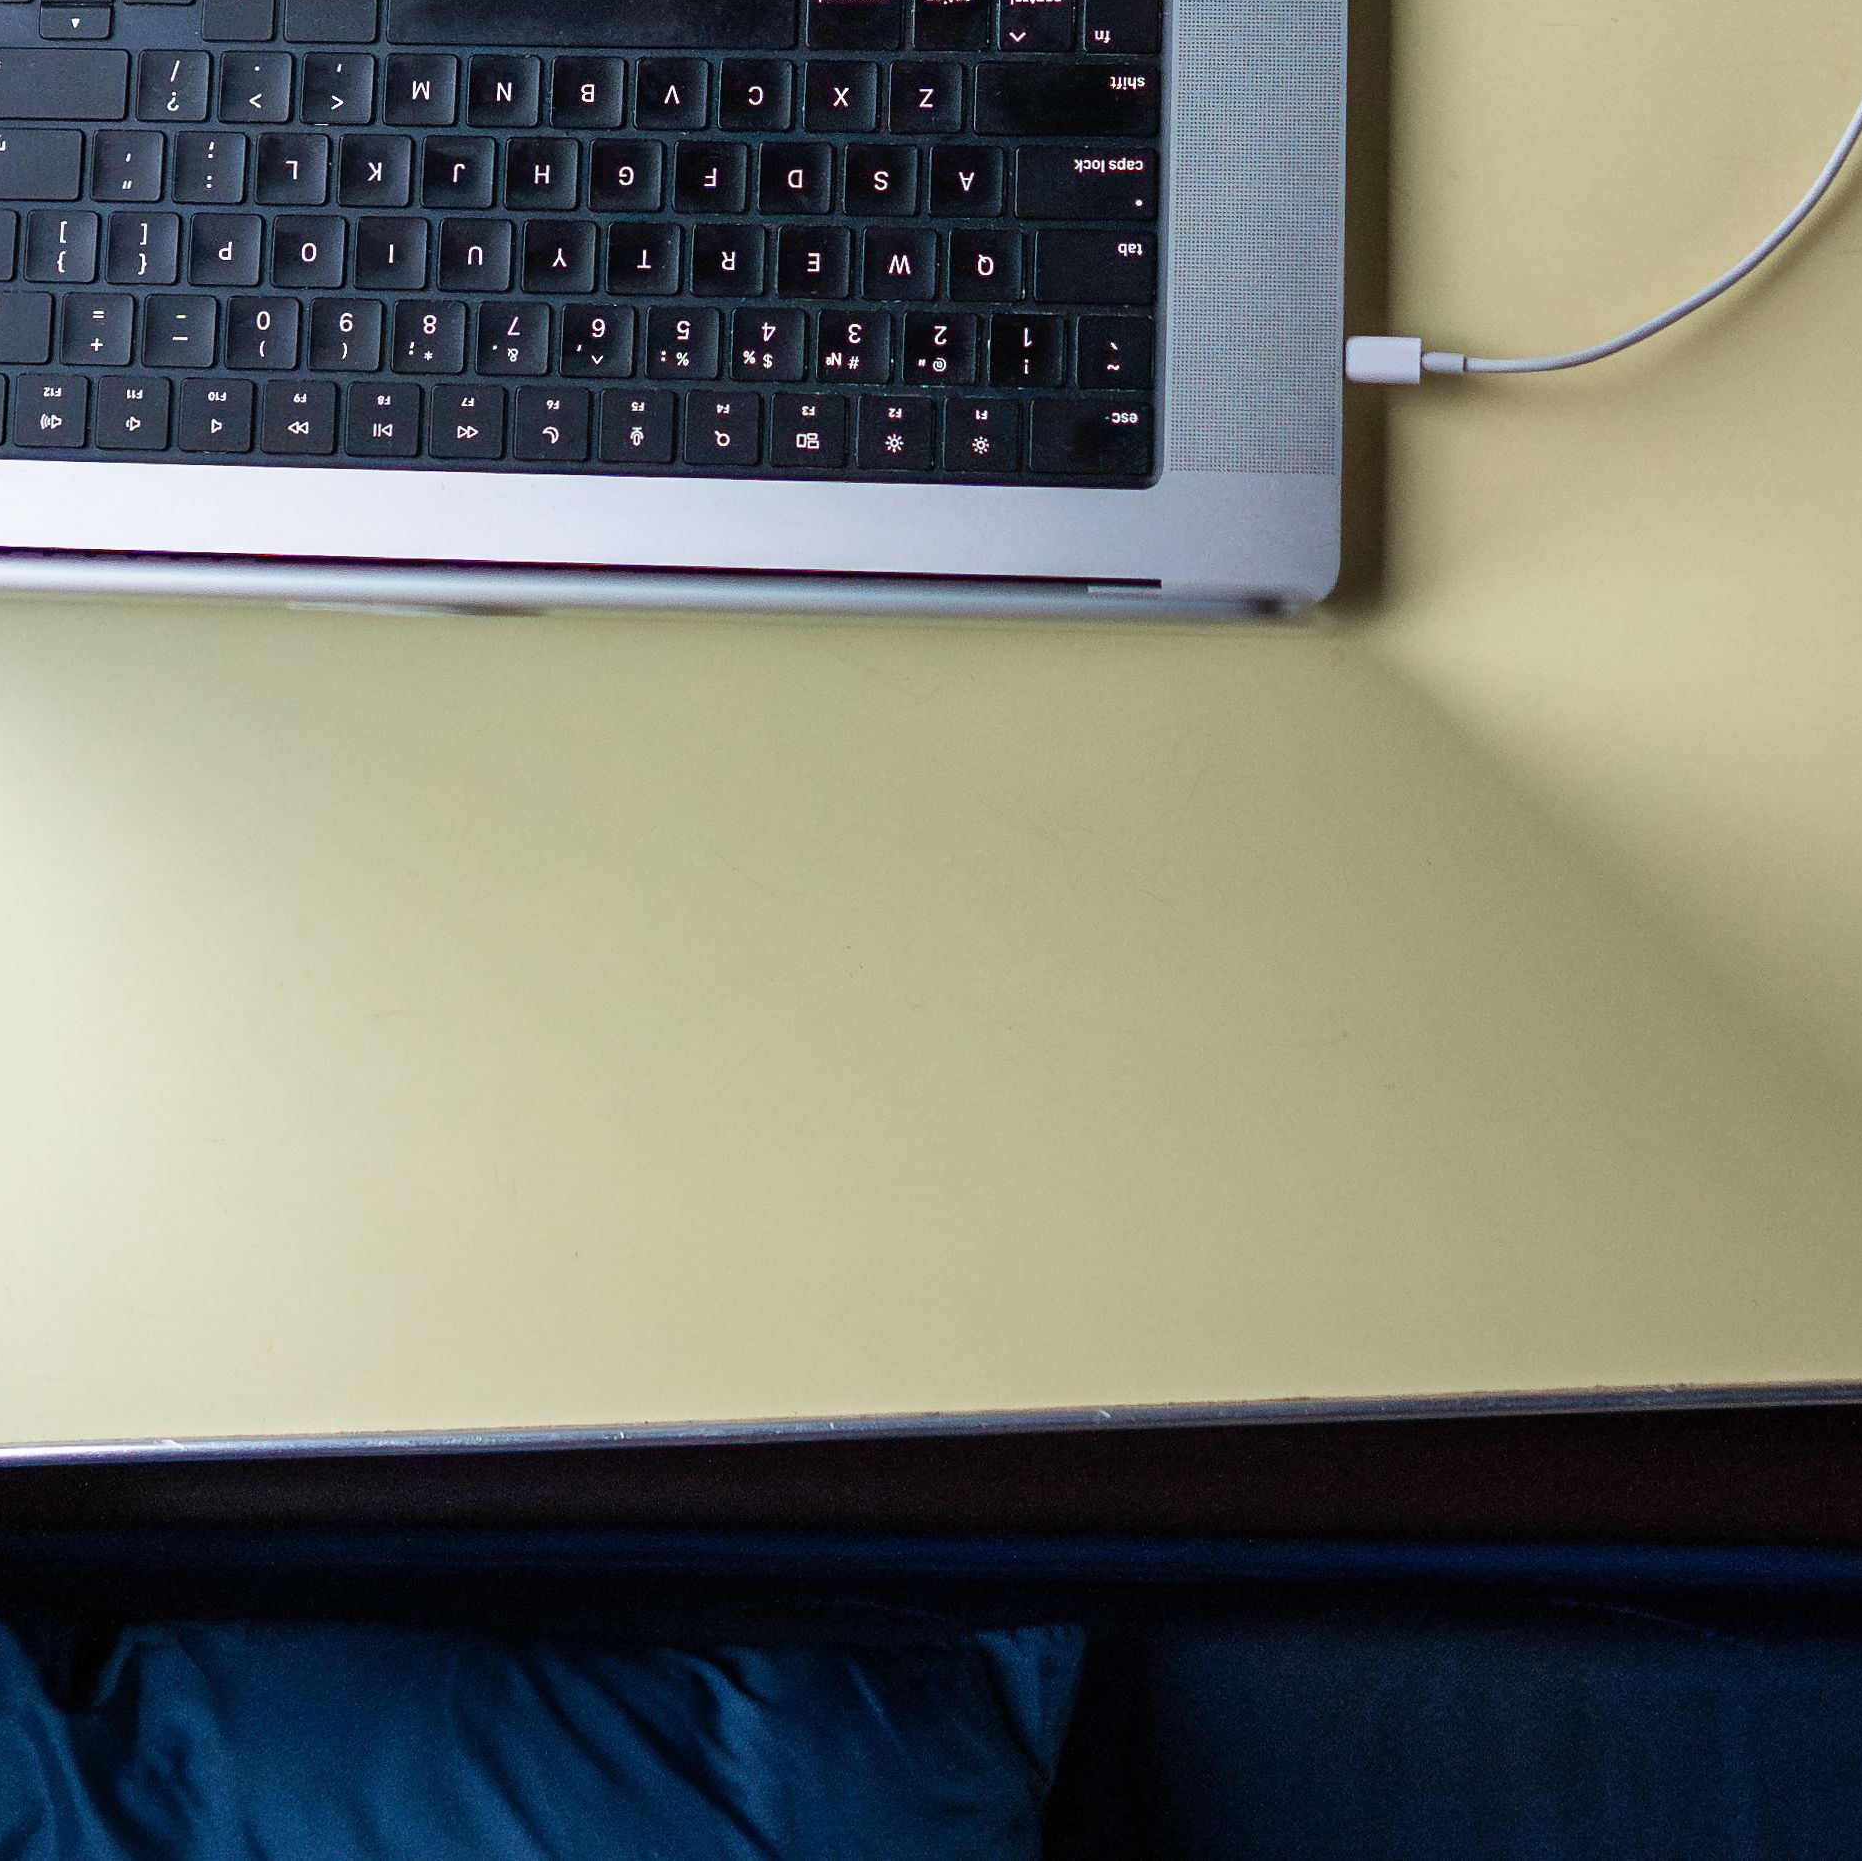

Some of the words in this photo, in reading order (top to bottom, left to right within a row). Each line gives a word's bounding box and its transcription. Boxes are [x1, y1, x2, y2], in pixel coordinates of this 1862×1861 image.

[1094, 29, 1112, 44] fn
[411, 80, 431, 101] M
[496, 81, 513, 102] N
[580, 83, 596, 103] B
[1109, 75, 1146, 91] shift
[663, 84, 681, 105] V
[748, 85, 764, 106] C
[832, 87, 850, 108] X
[918, 88, 934, 109] Z
[285, 159, 299, 180] L
[367, 161, 383, 182] K
[452, 163, 466, 183] J
[1073, 158, 1106, 174] lock
[1107, 156, 1144, 171] caps
[533, 164, 551, 185] H
[618, 165, 635, 186] G
[703, 167, 718, 188] F
[787, 168, 804, 189] D
[873, 170, 890, 191] S
[958, 171, 975, 192] A
[218, 240, 233, 261] P
[301, 242, 317, 263] O
[388, 243, 394, 264] I
[467, 245, 483, 266] U
[551, 247, 567, 268] Y
[636, 249, 652, 270] T
[1117, 242, 1144, 258] tab
[721, 251, 736, 271] R
[806, 252, 821, 273] E
[888, 254, 912, 275] W
[977, 253, 995, 276] Q
[256, 310, 271, 331] 0
[339, 312, 354, 333] 9
[422, 314, 438, 335] 8
[506, 316, 521, 336] 7
[591, 318, 606, 338] 6
[676, 320, 692, 341] 5
[761, 321, 777, 342] 4
[847, 323, 863, 344] 3
[933, 325, 948, 346] 2
[1023, 327, 1033, 348] 1
[43, 386, 62, 398] F12
[126, 388, 144, 400] F11
[207, 391, 227, 402] F10
[292, 392, 307, 404] F9
[376, 394, 391, 406] F8
[460, 397, 475, 407] F7
[546, 399, 560, 410] F6
[630, 401, 645, 412] F5
[715, 403, 731, 414] F4
[801, 405, 816, 417] F3
[887, 407, 903, 419] F2
[975, 409, 989, 421] F1
[1110, 412, 1139, 424] esc
